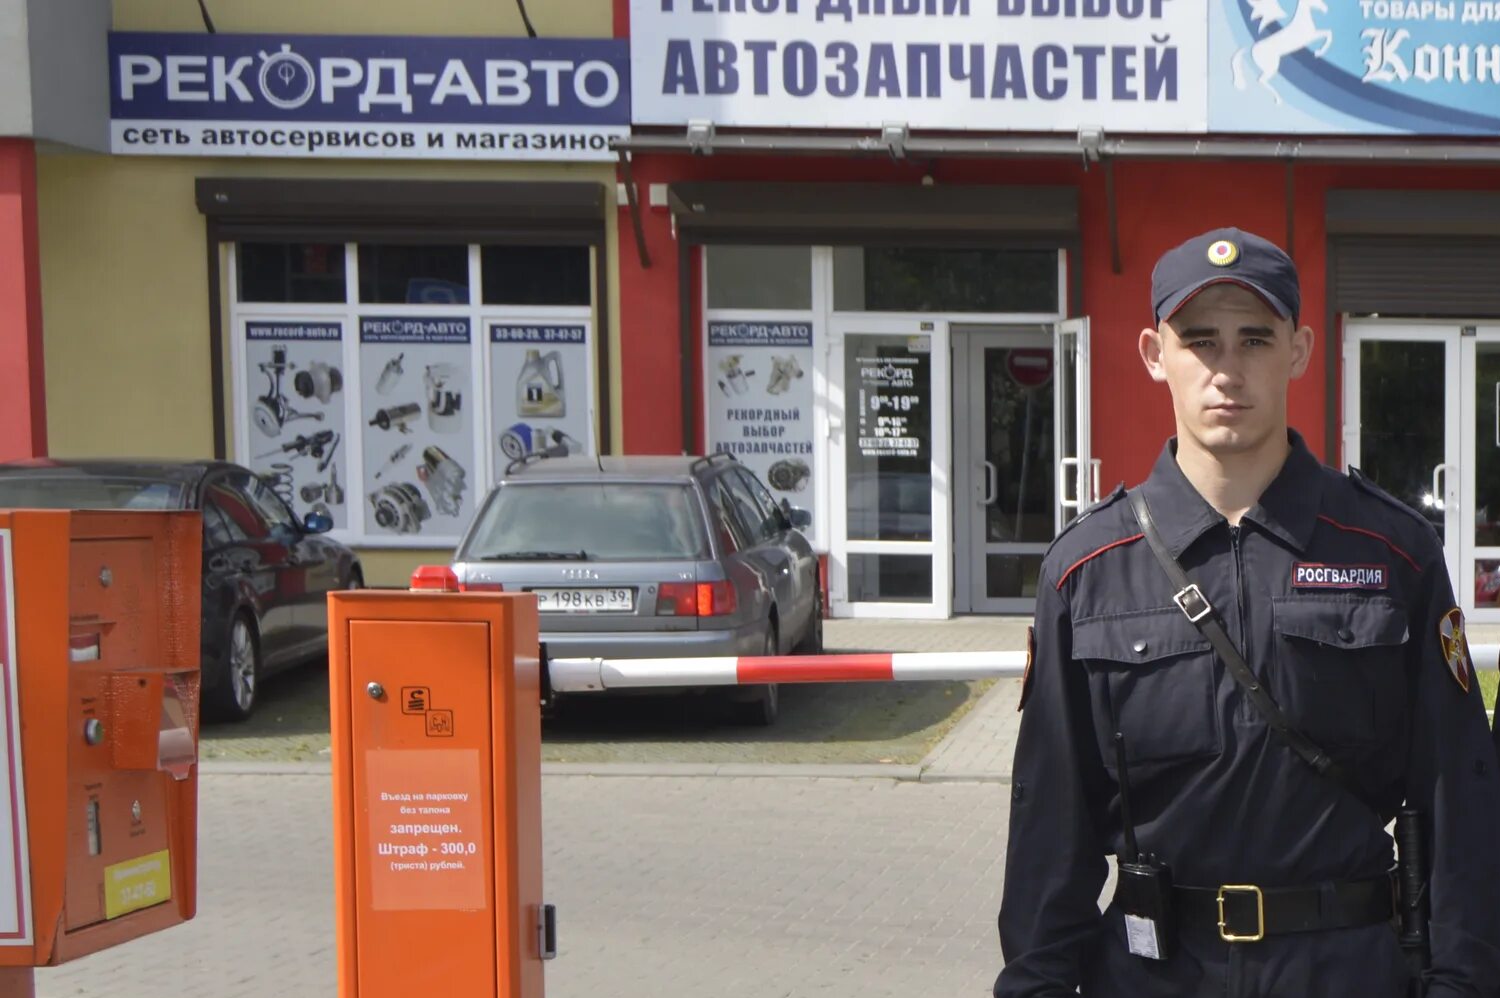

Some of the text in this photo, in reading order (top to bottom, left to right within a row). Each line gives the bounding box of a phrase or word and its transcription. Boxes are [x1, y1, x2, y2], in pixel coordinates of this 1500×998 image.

[1360, 1, 1455, 20] ТОВАРЫ
[662, 34, 1178, 101] АВТОЗАПЧАСТЕЙ
[119, 44, 620, 114] РЕКОРД-АВТО
[123, 127, 190, 145] сеть
[202, 127, 415, 152] автосервисов
[427, 132, 444, 148] и
[363, 319, 467, 335] РЕКОРД-АВТО
[710, 323, 809, 338] РЕКОРД-АВТО
[727, 407, 800, 423] РЕКОРДНЫЙ
[742, 426, 785, 438] ВЫБОР
[716, 441, 813, 454] АВТОЗАПЧАСТЕЙ
[1297, 567, 1382, 584] РОСГВАРДИЯ
[381, 792, 411, 802] Въезд
[426, 793, 469, 802] парковку
[400, 806, 417, 814] без
[390, 824, 462, 836] запрещен.
[378, 842, 428, 857] Штраф
[440, 842, 476, 856] 300,0
[390, 861, 465, 871] (триста) рублей.
